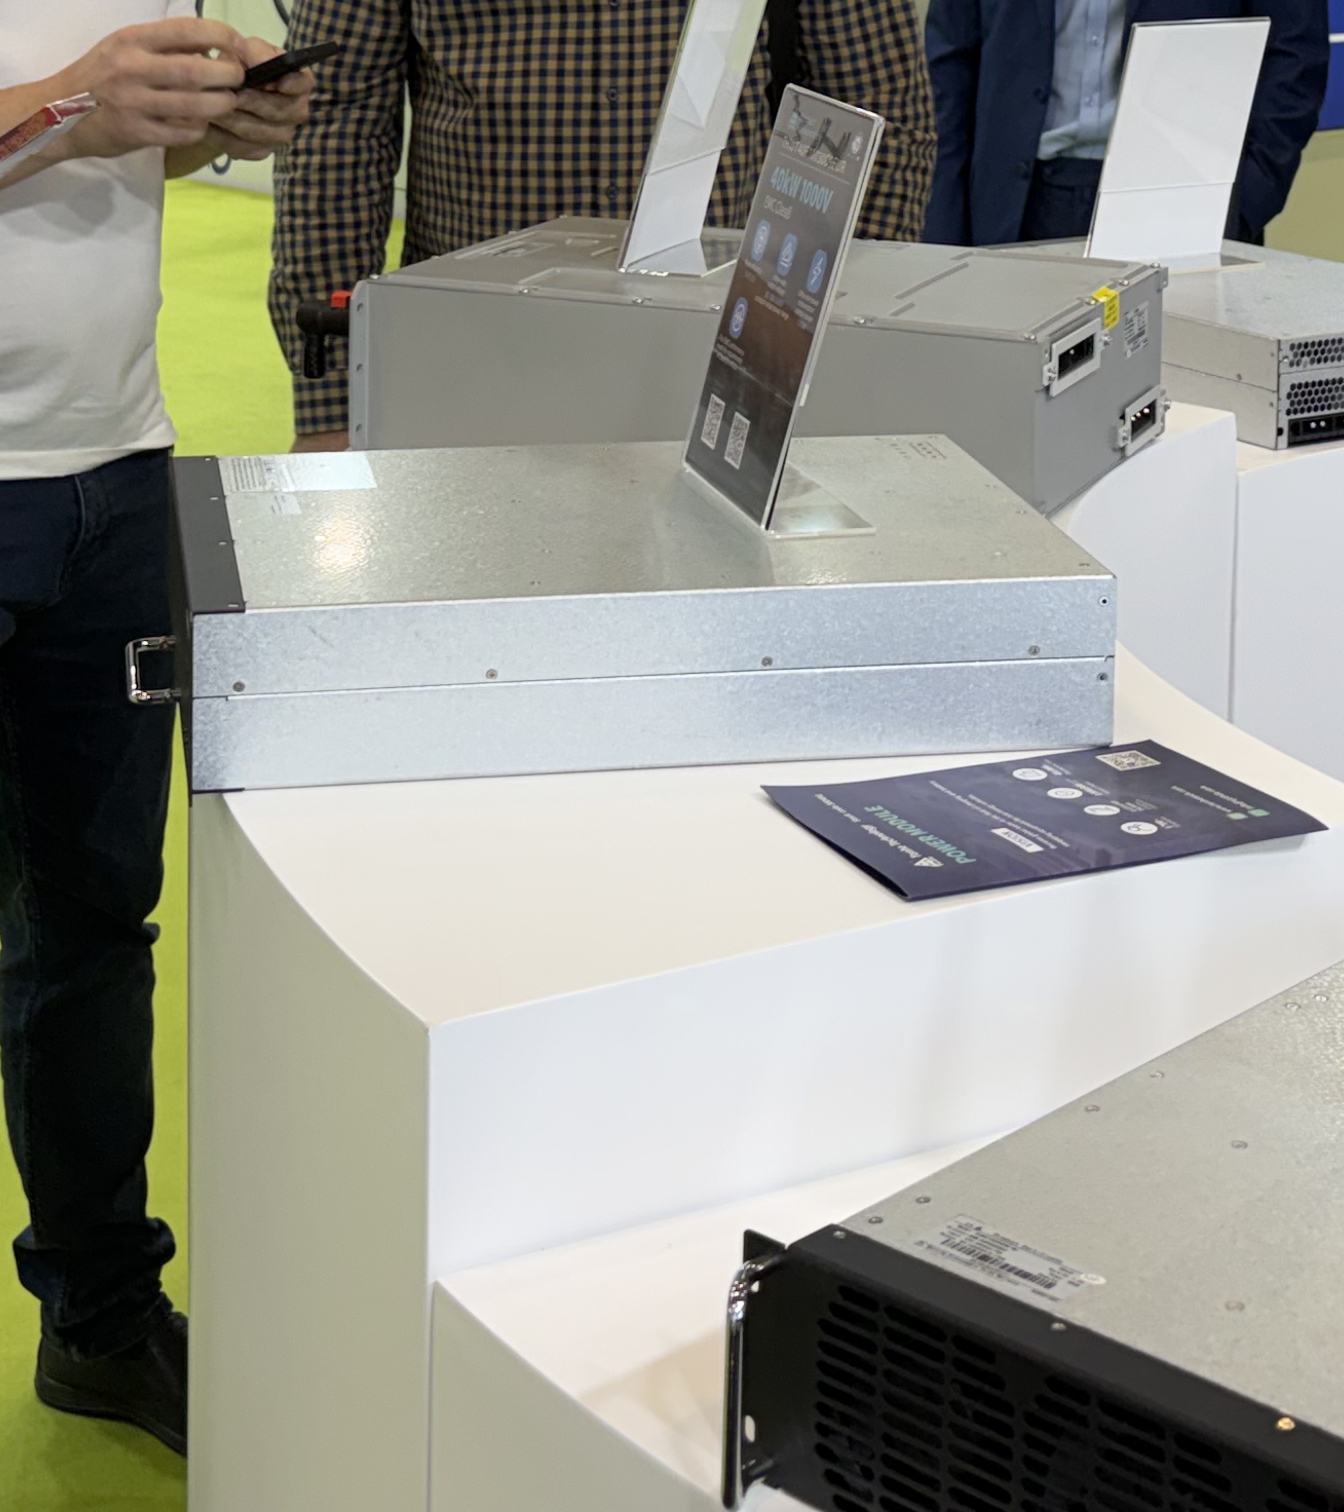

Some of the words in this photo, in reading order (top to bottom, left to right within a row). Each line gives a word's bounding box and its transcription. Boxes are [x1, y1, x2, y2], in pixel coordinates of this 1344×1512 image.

[770, 167, 803, 198] 40kW
[800, 179, 834, 214] 1000V
[864, 805, 928, 836] MODULE
[918, 831, 976, 864] POWER
